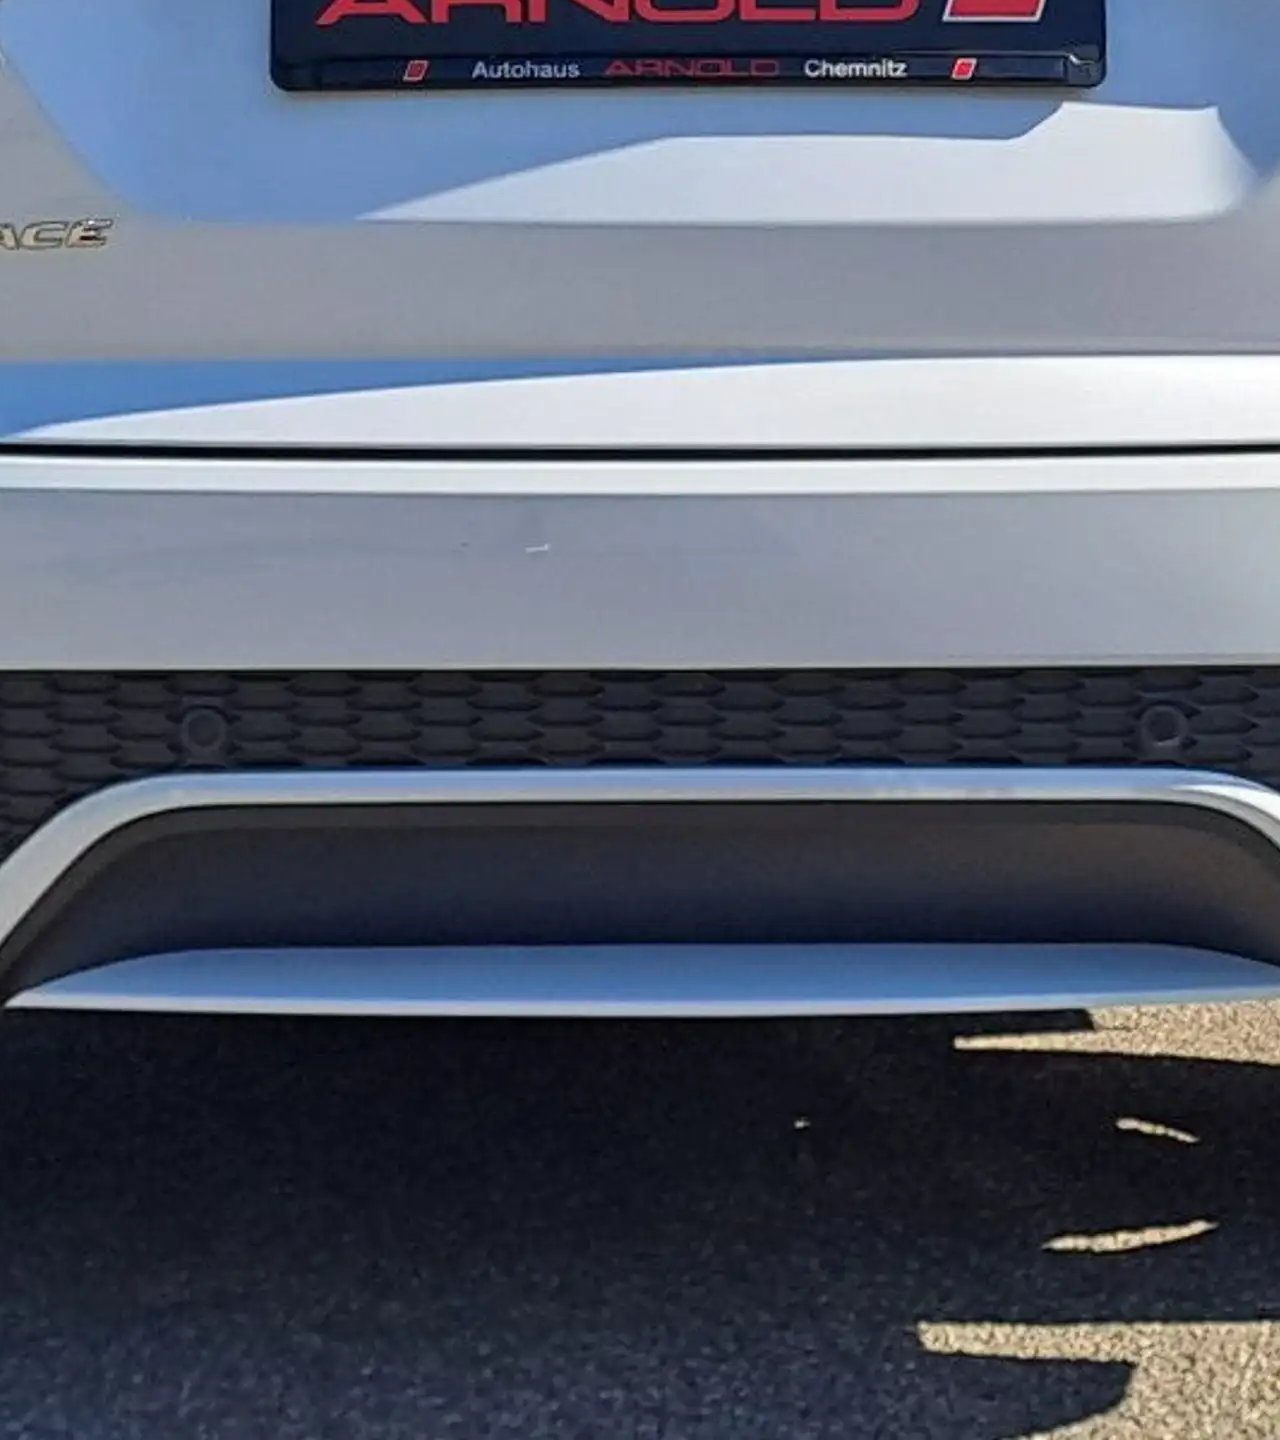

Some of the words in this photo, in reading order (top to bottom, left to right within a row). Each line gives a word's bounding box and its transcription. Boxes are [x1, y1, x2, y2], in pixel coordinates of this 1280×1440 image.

[471, 58, 581, 79] Autohaus
[603, 59, 781, 78] ARNOLD
[803, 57, 908, 79] Chemnitz
